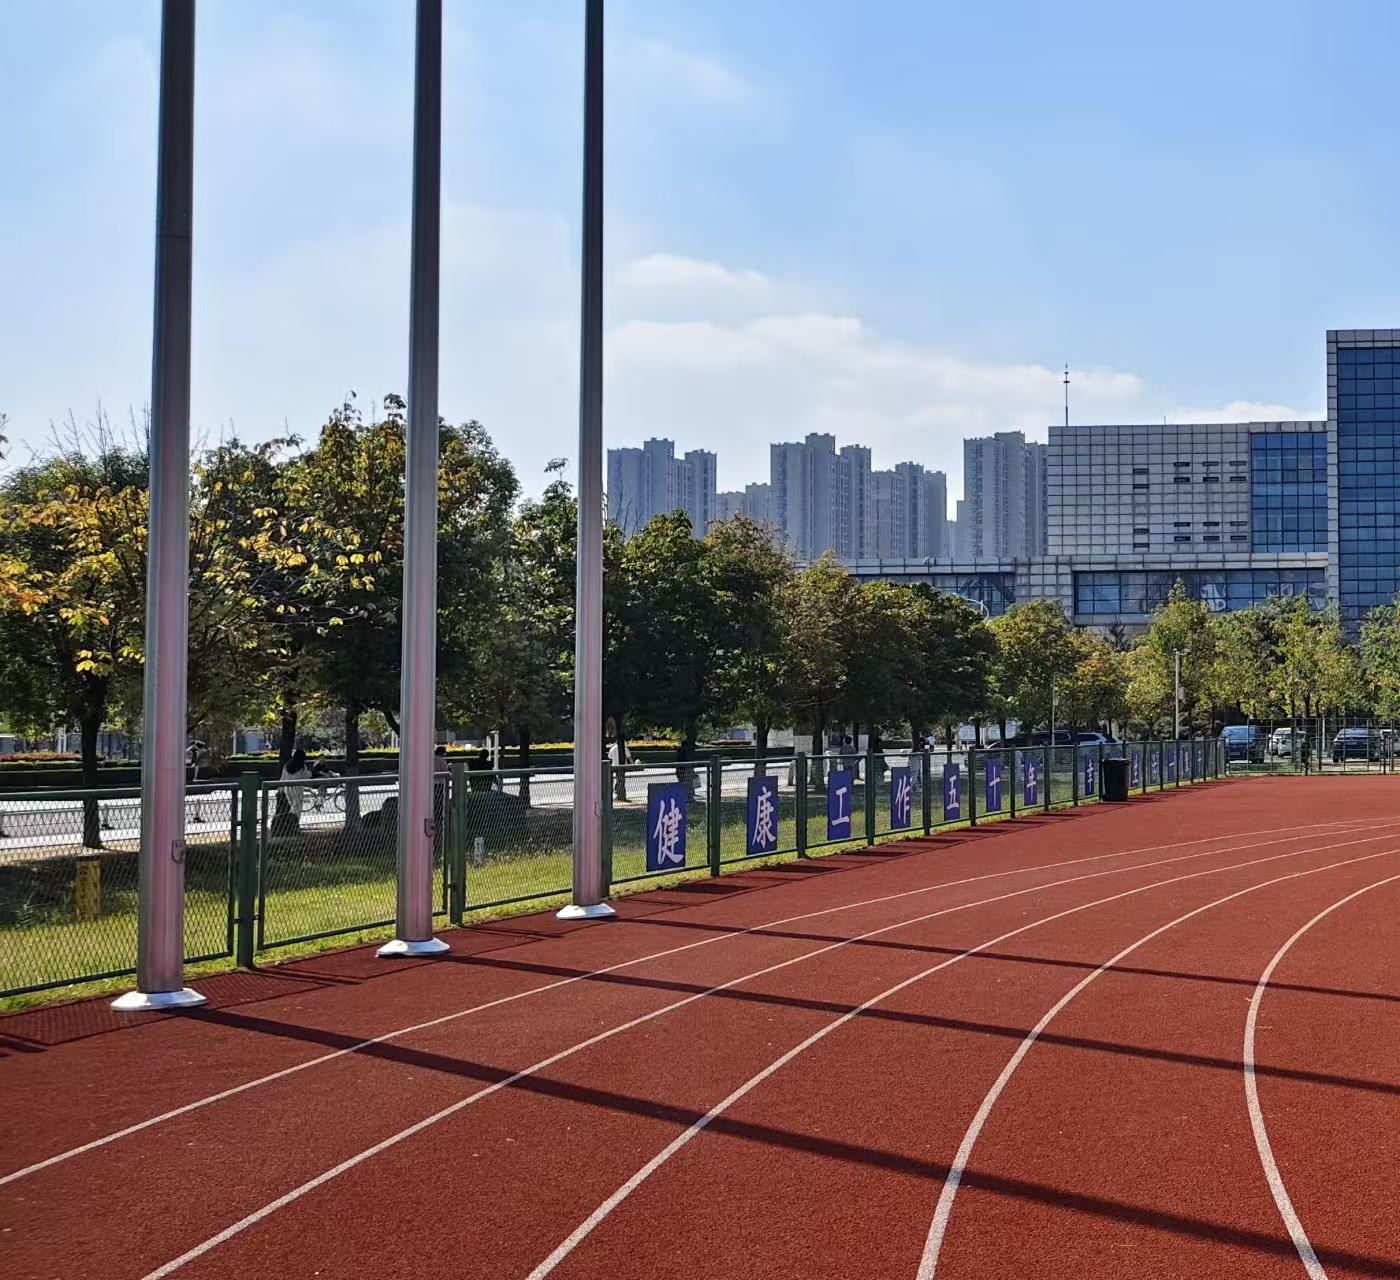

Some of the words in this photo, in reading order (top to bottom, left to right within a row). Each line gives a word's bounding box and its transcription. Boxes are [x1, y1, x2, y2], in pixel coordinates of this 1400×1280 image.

[653, 798, 684, 865] 健
[752, 786, 777, 848] 康
[831, 786, 850, 826] 工
[895, 775, 911, 824] 作
[947, 775, 959, 810] 五
[989, 766, 1001, 808] 十
[1026, 763, 1037, 802] 年
